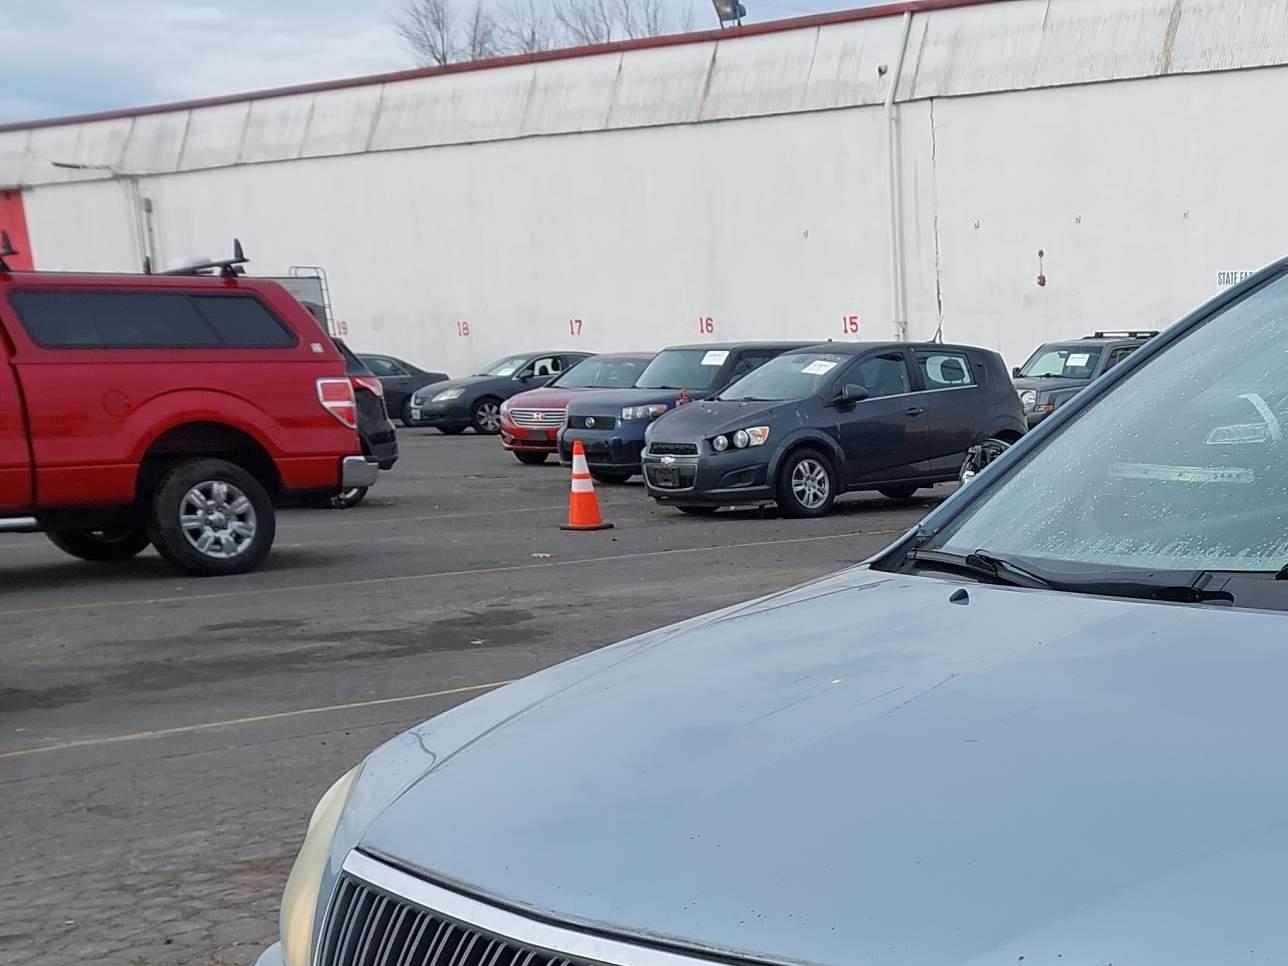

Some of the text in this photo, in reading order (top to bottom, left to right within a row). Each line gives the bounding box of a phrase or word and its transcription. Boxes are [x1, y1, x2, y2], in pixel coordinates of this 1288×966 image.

[456, 320, 470, 337] 18
[569, 319, 583, 336] 17
[698, 316, 714, 334] 16
[842, 316, 859, 334] 15
